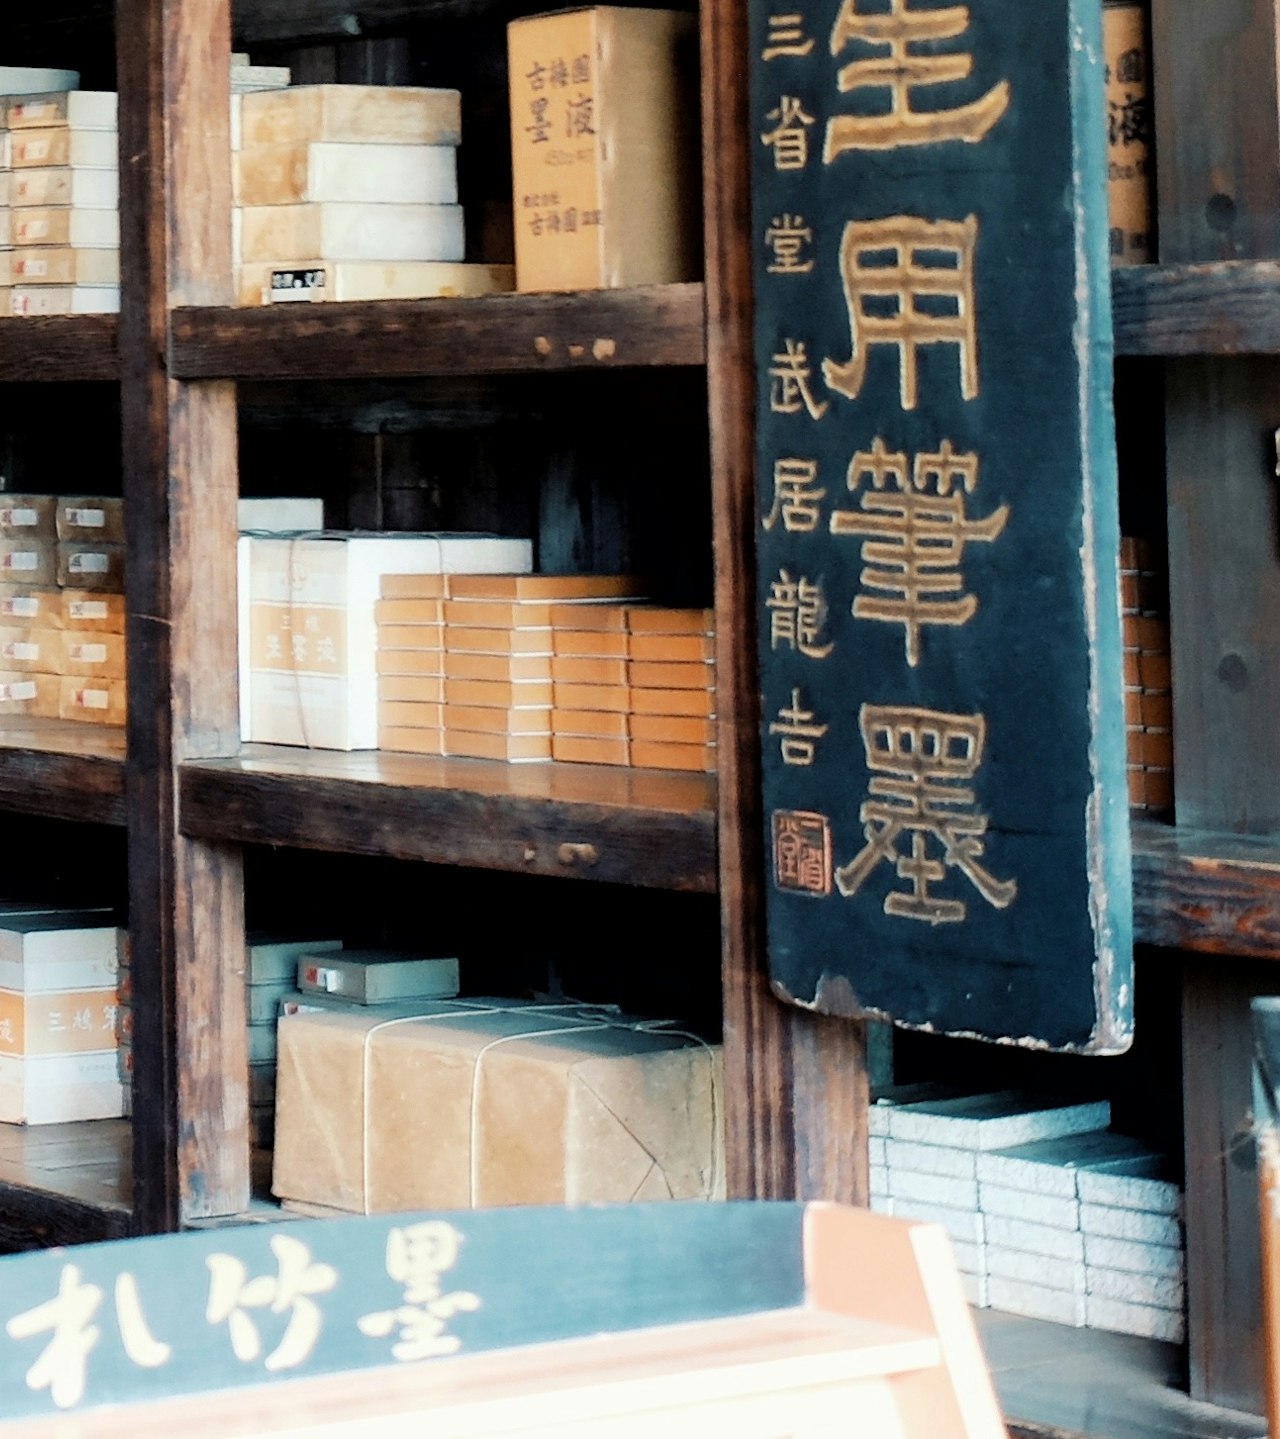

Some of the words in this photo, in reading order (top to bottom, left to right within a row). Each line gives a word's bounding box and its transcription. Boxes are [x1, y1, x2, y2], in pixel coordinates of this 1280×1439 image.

[524, 93, 597, 145] 墨液
[760, 13, 817, 274] 三省堂
